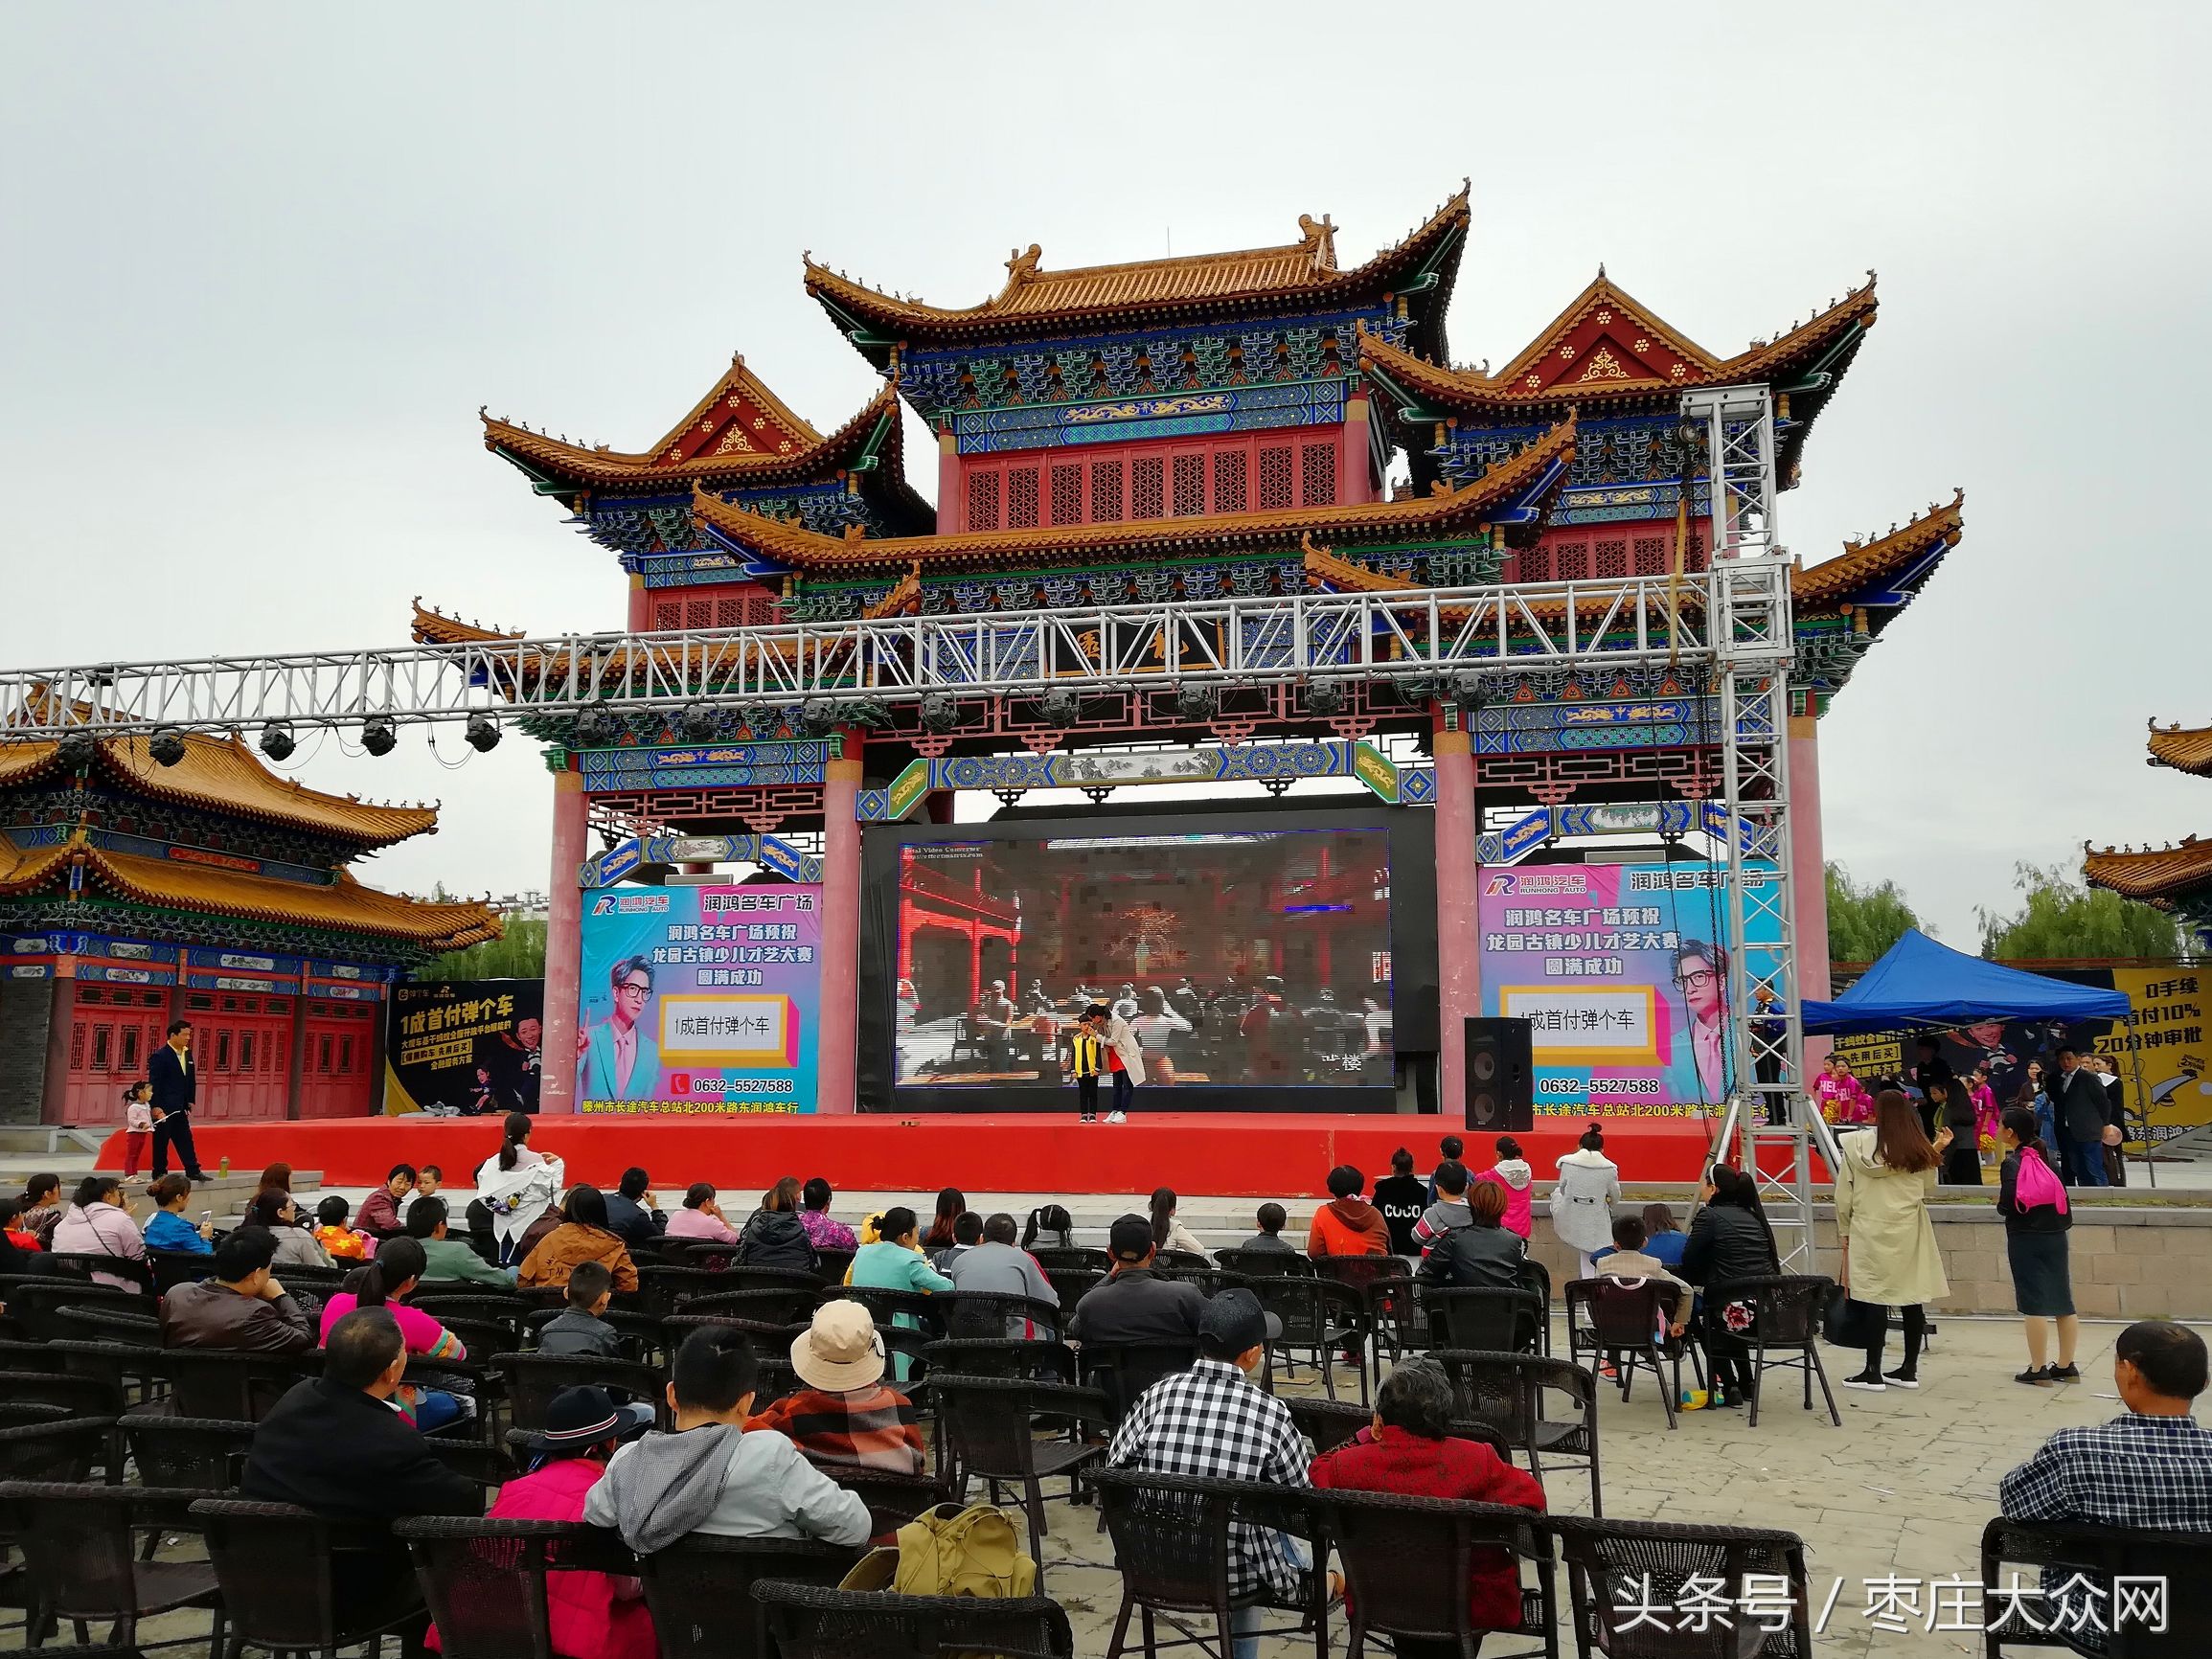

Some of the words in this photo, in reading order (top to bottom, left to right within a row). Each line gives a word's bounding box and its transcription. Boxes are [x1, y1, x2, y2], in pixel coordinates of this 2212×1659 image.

[1519, 875, 1586, 887] 润鸿汽车
[704, 894, 813, 911] 润鸿名车广场
[1505, 907, 1661, 927] 润鸿名车广场预祝
[668, 924, 797, 942] 润鸿名车广场预祝
[1487, 933, 1680, 951] 龙园古镇少儿才艺大赛
[652, 946, 813, 964] 龙园古镇少儿才艺大赛
[1545, 957, 1623, 976] 圆满成功
[697, 969, 763, 987] 圆满成功
[400, 994, 513, 1034] 1成首付弹个车
[675, 1016, 770, 1035] 1成首付弹个车
[2096, 1026, 2202, 1055] 20分钟审批
[694, 1079, 793, 1093] 0632-5527588
[1539, 1079, 1659, 1094] 0632-5527588
[1533, 1102, 1769, 1118] 市长途汽车总站北200米路东润
